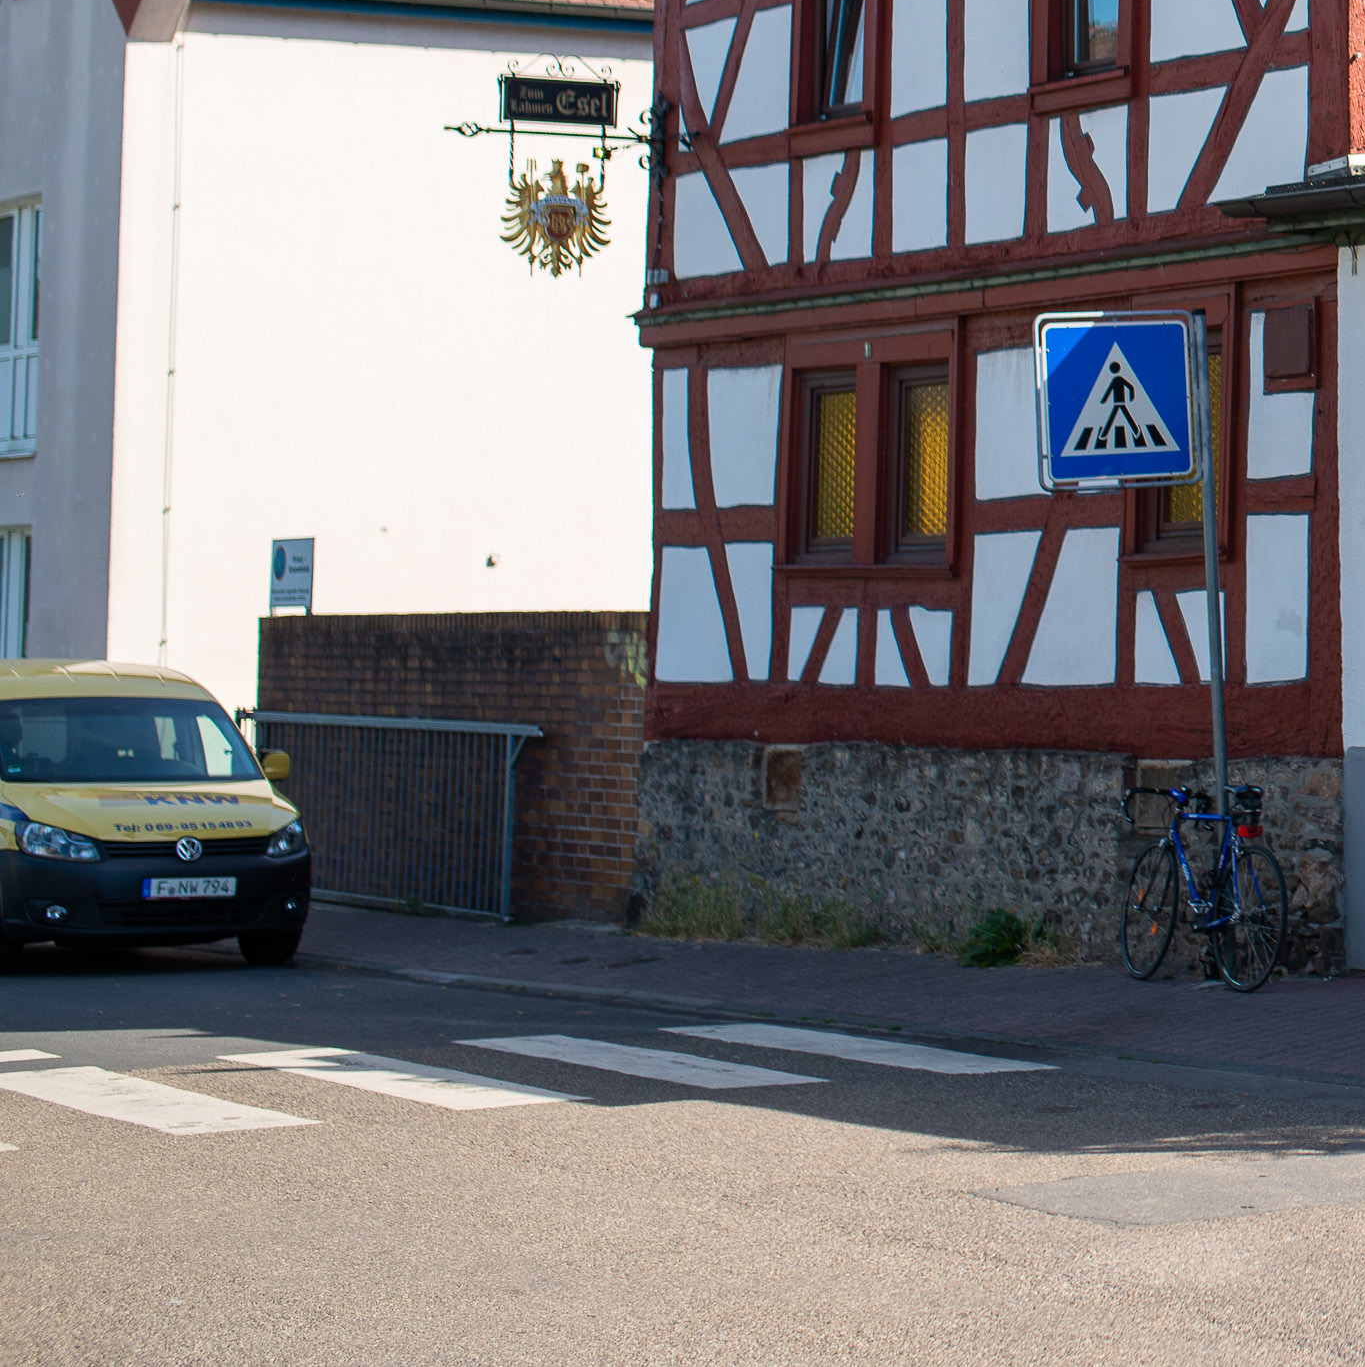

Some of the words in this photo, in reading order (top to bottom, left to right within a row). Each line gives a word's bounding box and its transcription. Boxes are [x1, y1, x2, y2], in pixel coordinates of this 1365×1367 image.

[520, 85, 544, 100] Zum
[509, 97, 553, 115] Lahmen
[556, 89, 608, 118] Esel
[202, 877, 230, 894] 794
